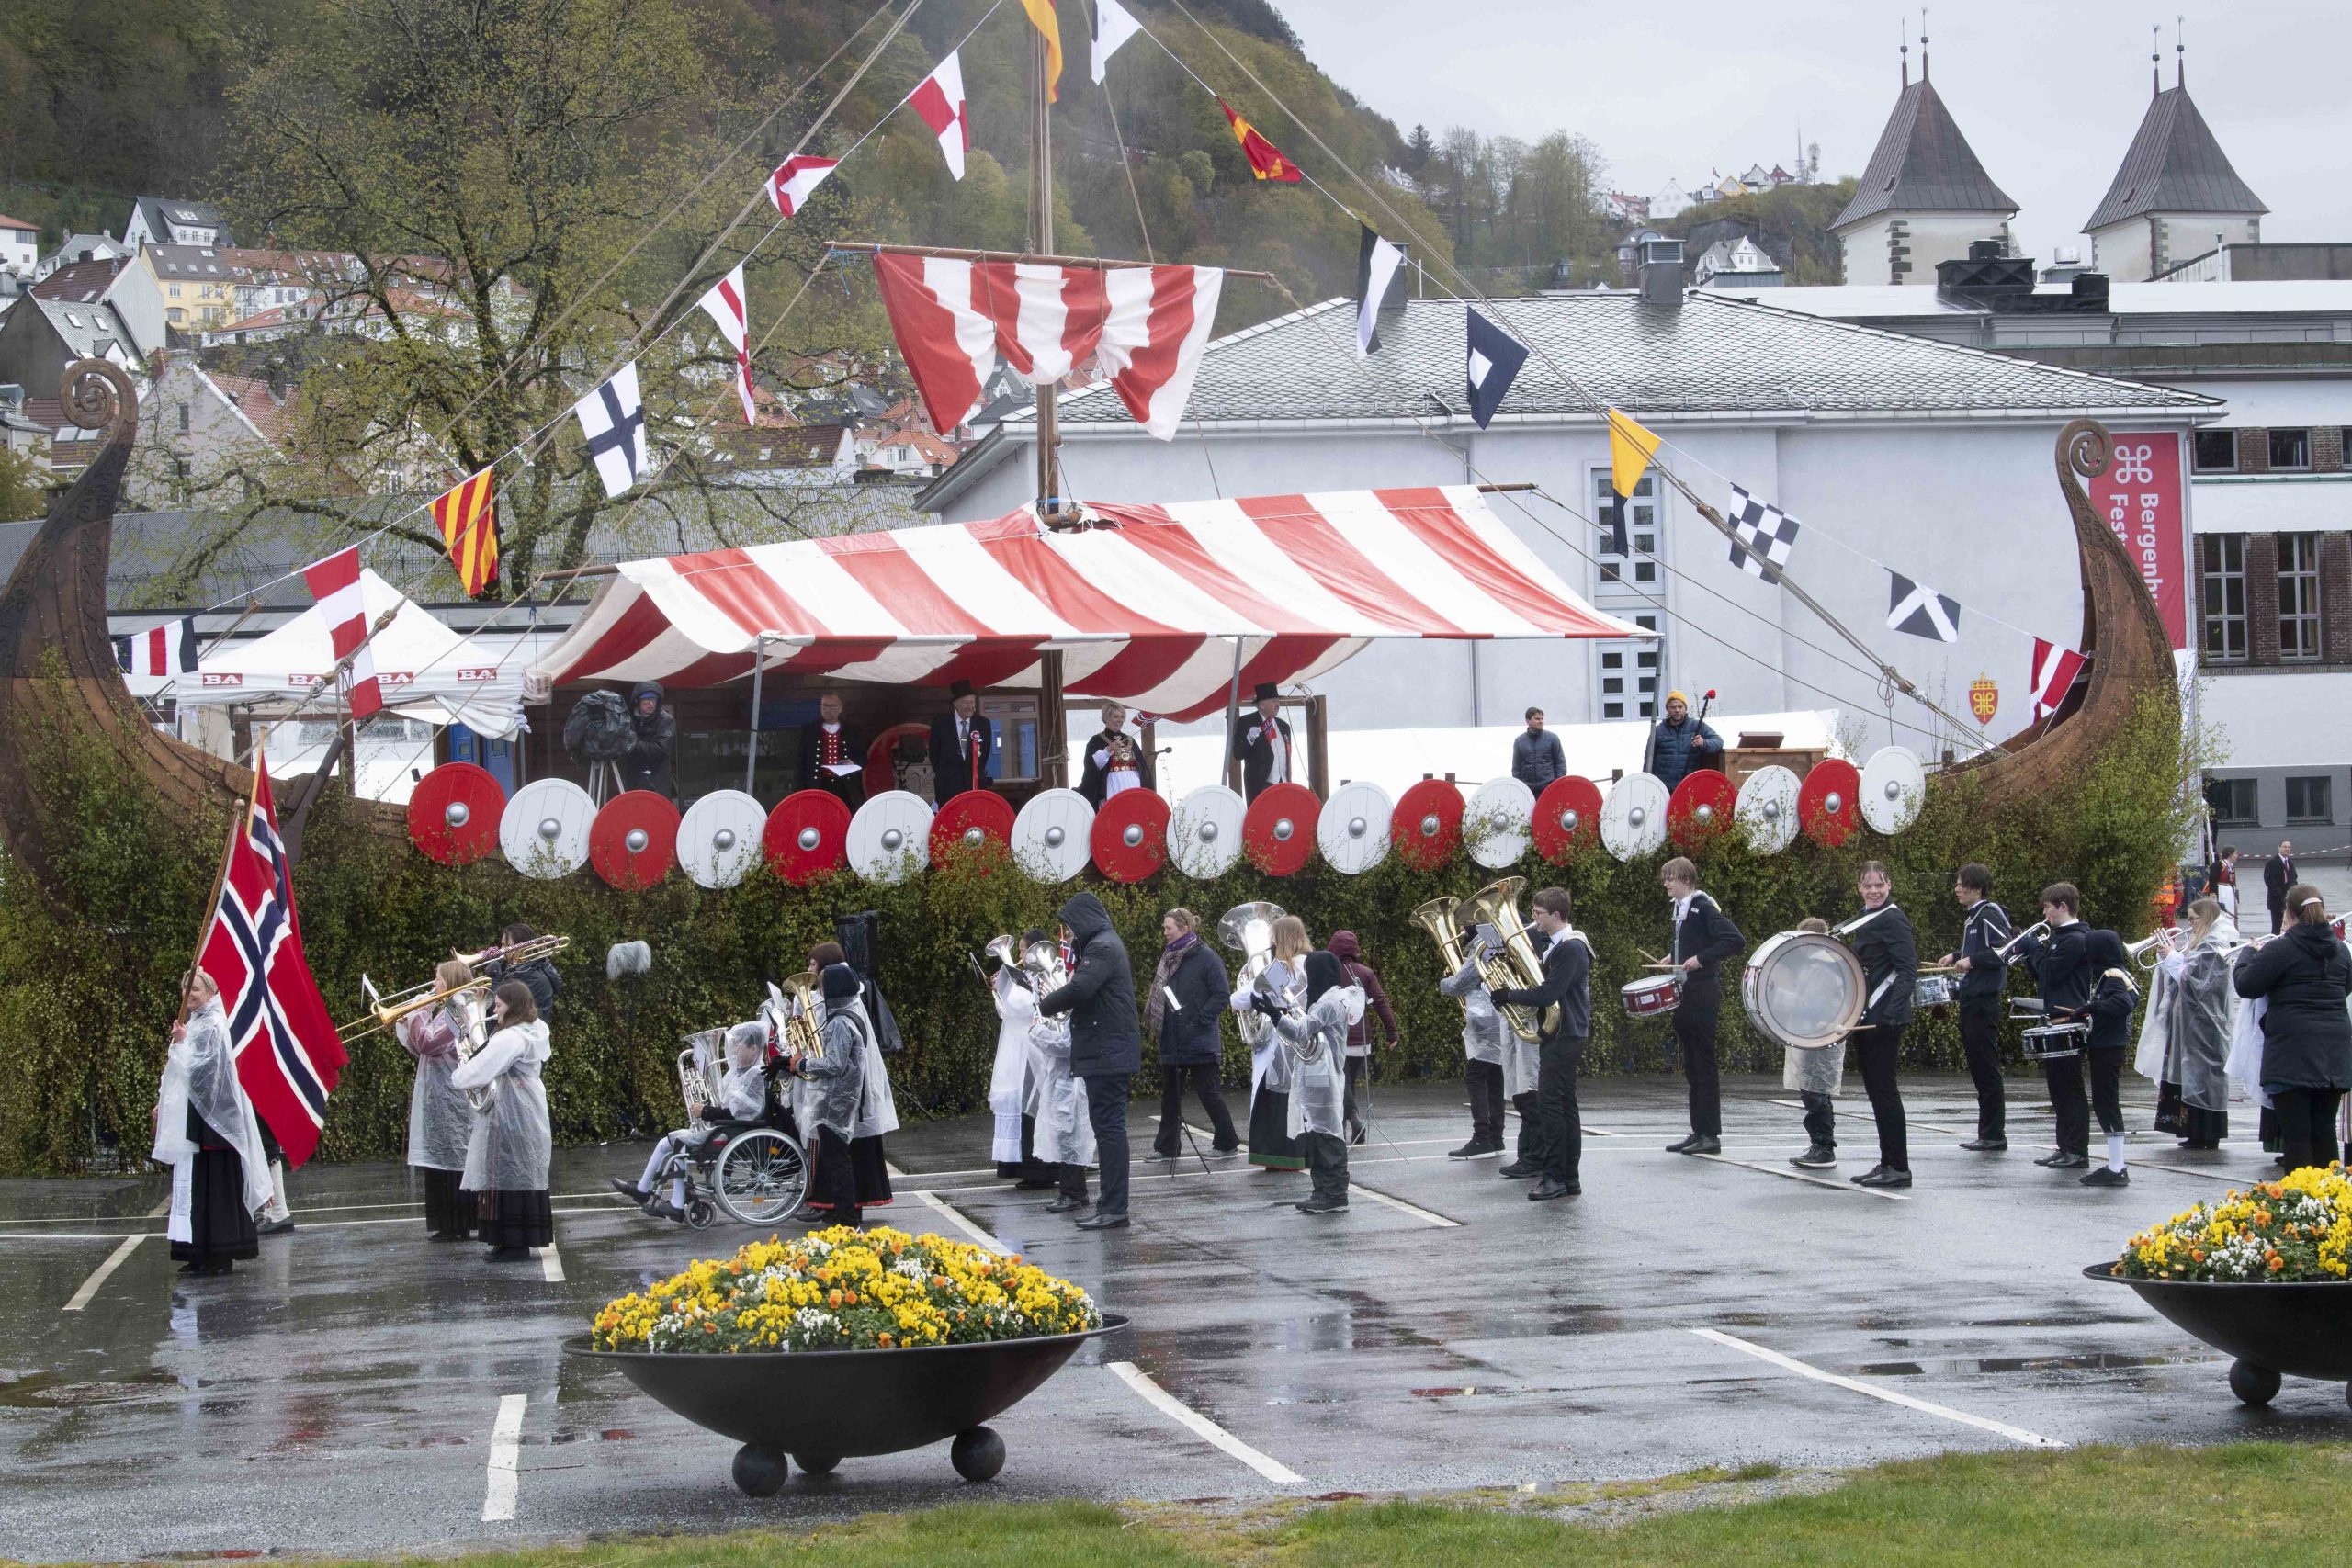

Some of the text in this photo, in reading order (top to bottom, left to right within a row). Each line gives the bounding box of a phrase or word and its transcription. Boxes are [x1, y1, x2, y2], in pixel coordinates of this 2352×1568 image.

[2109, 494, 2129, 548] Fest
[204, 675, 242, 685] BA
[290, 674, 322, 685] BA
[377, 673, 410, 683] BA
[458, 670, 495, 680] BA
